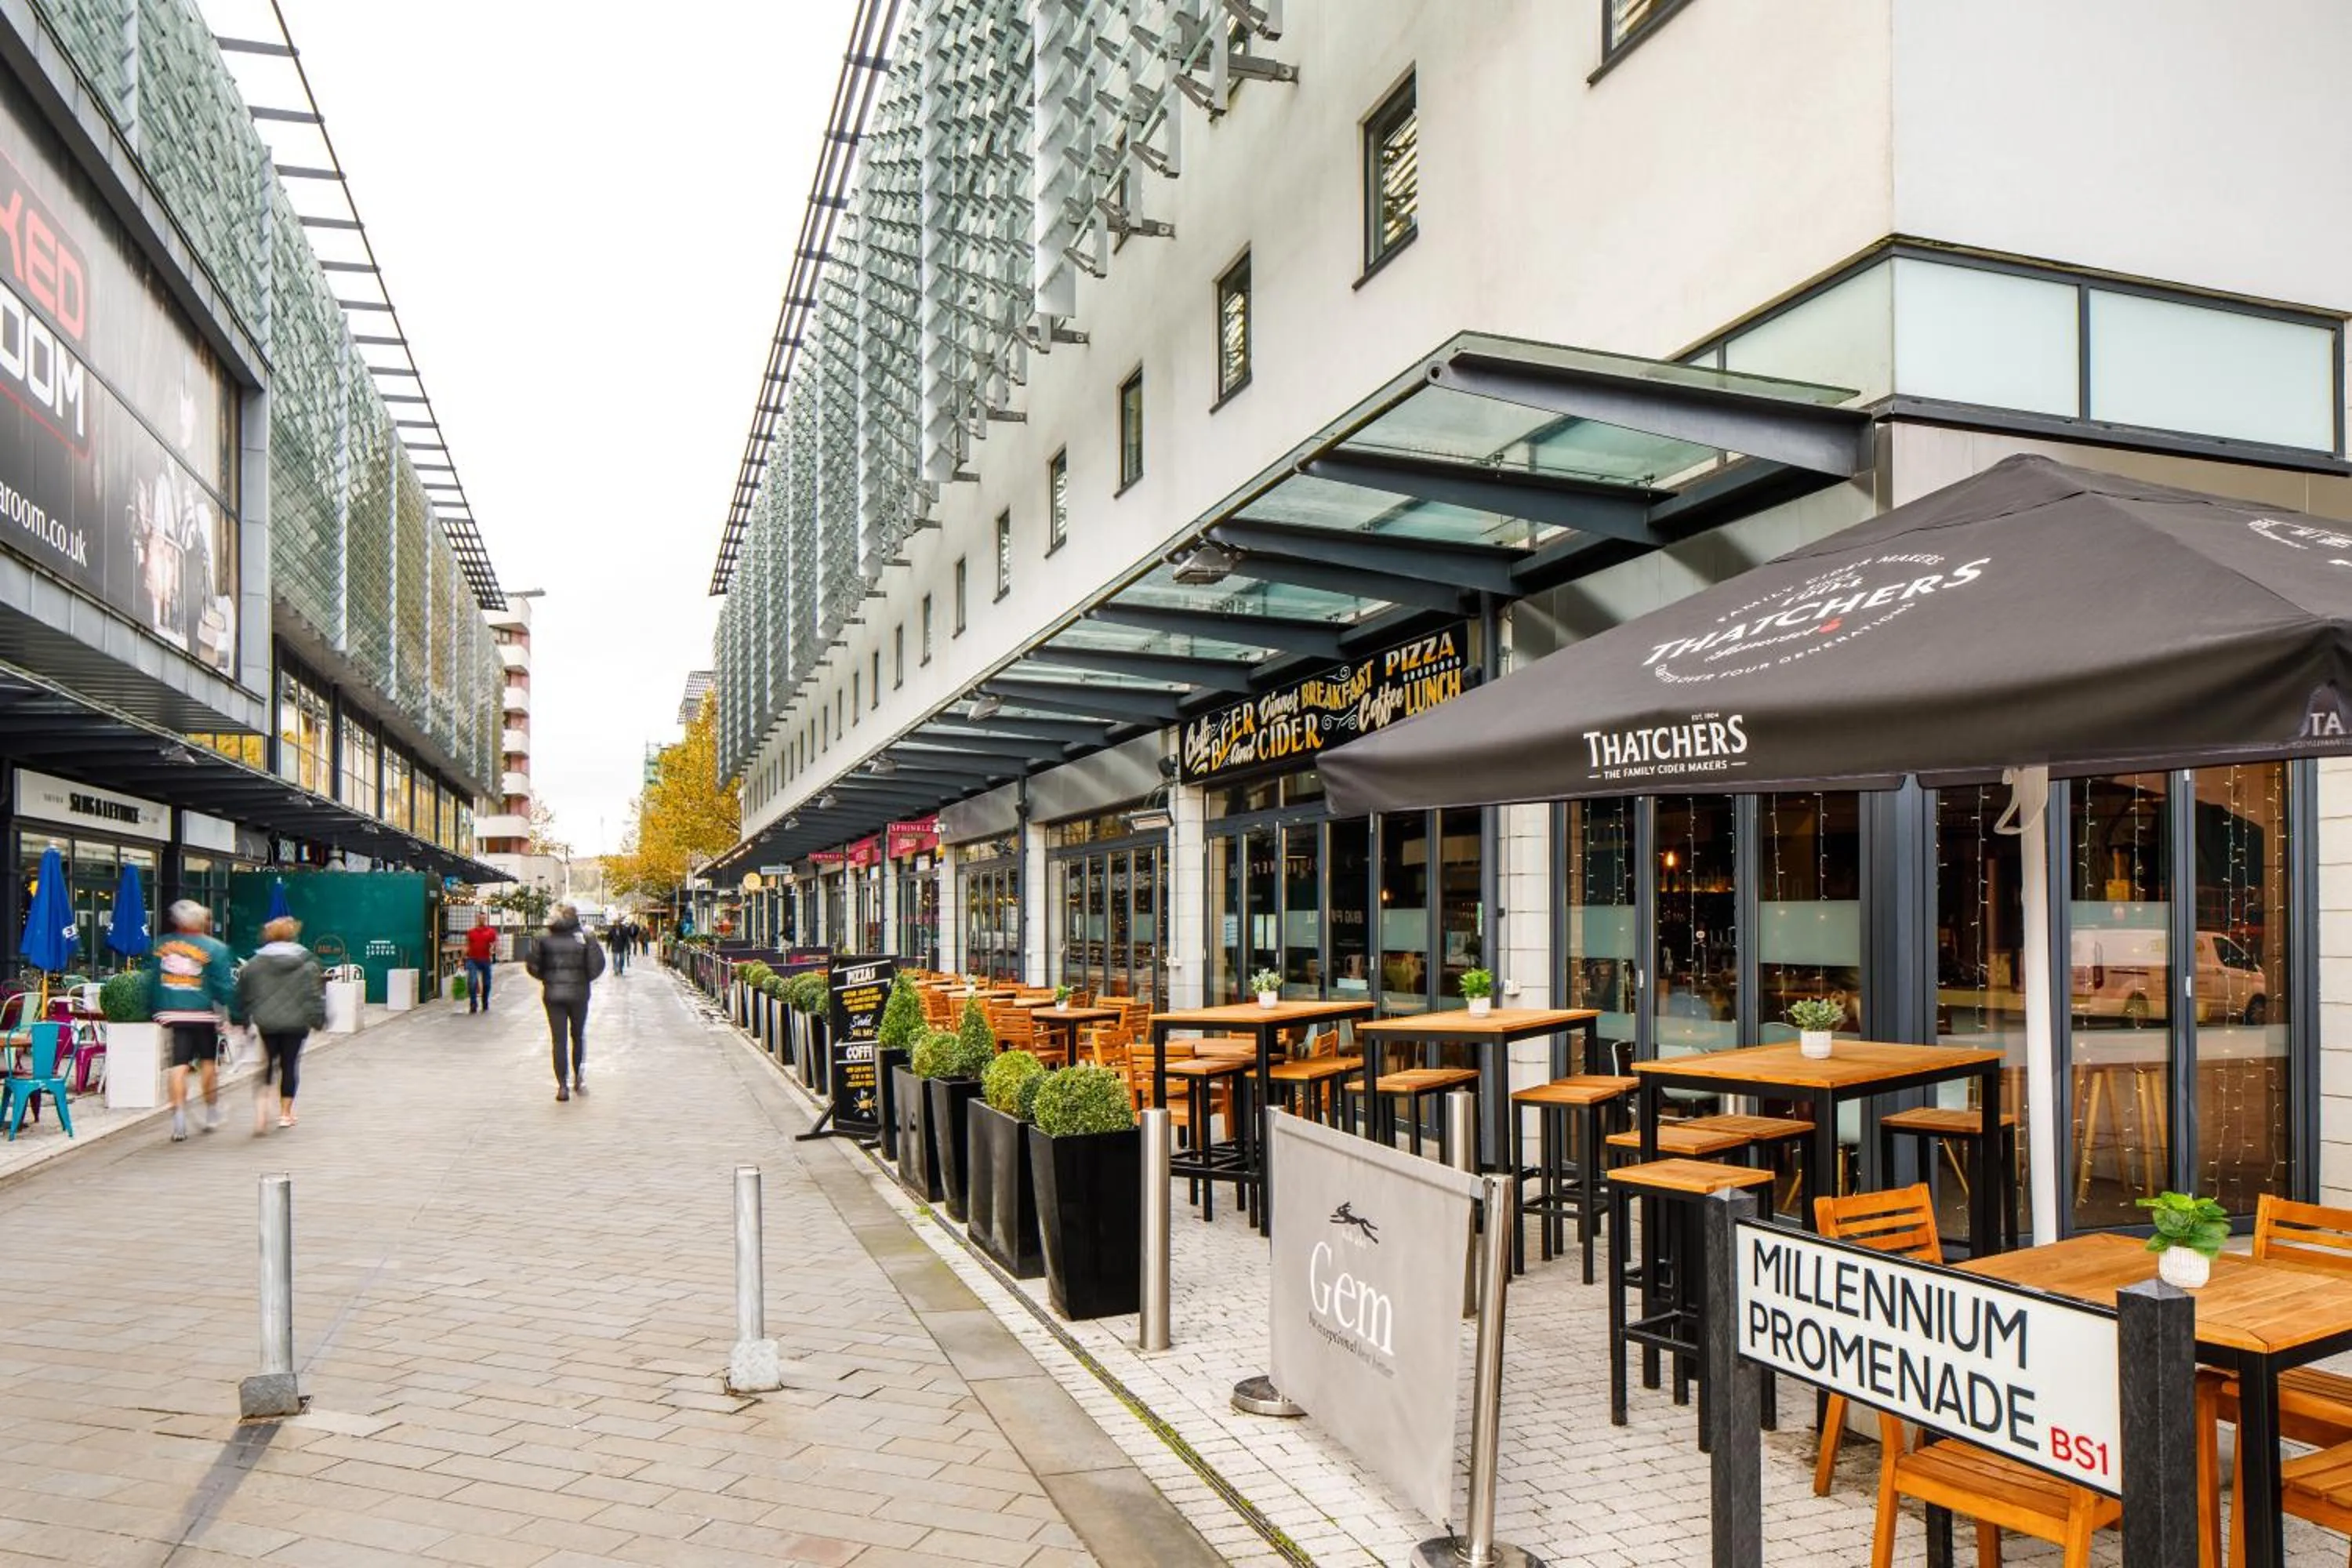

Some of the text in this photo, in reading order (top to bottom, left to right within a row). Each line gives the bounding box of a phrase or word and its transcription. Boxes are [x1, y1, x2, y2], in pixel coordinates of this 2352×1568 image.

[1642, 558, 1991, 666] THATCHERS
[1385, 631, 1455, 677] PIZZA
[1719, 663, 1769, 678] FOUR
[1301, 659, 1375, 711] BREAKFAST
[1358, 681, 1406, 733] Coffee
[1404, 668, 1461, 717] LUNCH
[1211, 702, 1256, 771] BEER
[1258, 713, 1324, 762] CIDER
[1583, 714, 1748, 768] THATCHERS
[1604, 760, 1727, 780] THE FAMILY CIDER MAKERS
[1309, 1241, 1395, 1356] Gem
[1753, 1238, 2028, 1370] MILLENNIUM
[1749, 1299, 2109, 1476] PROMENADE BS1
